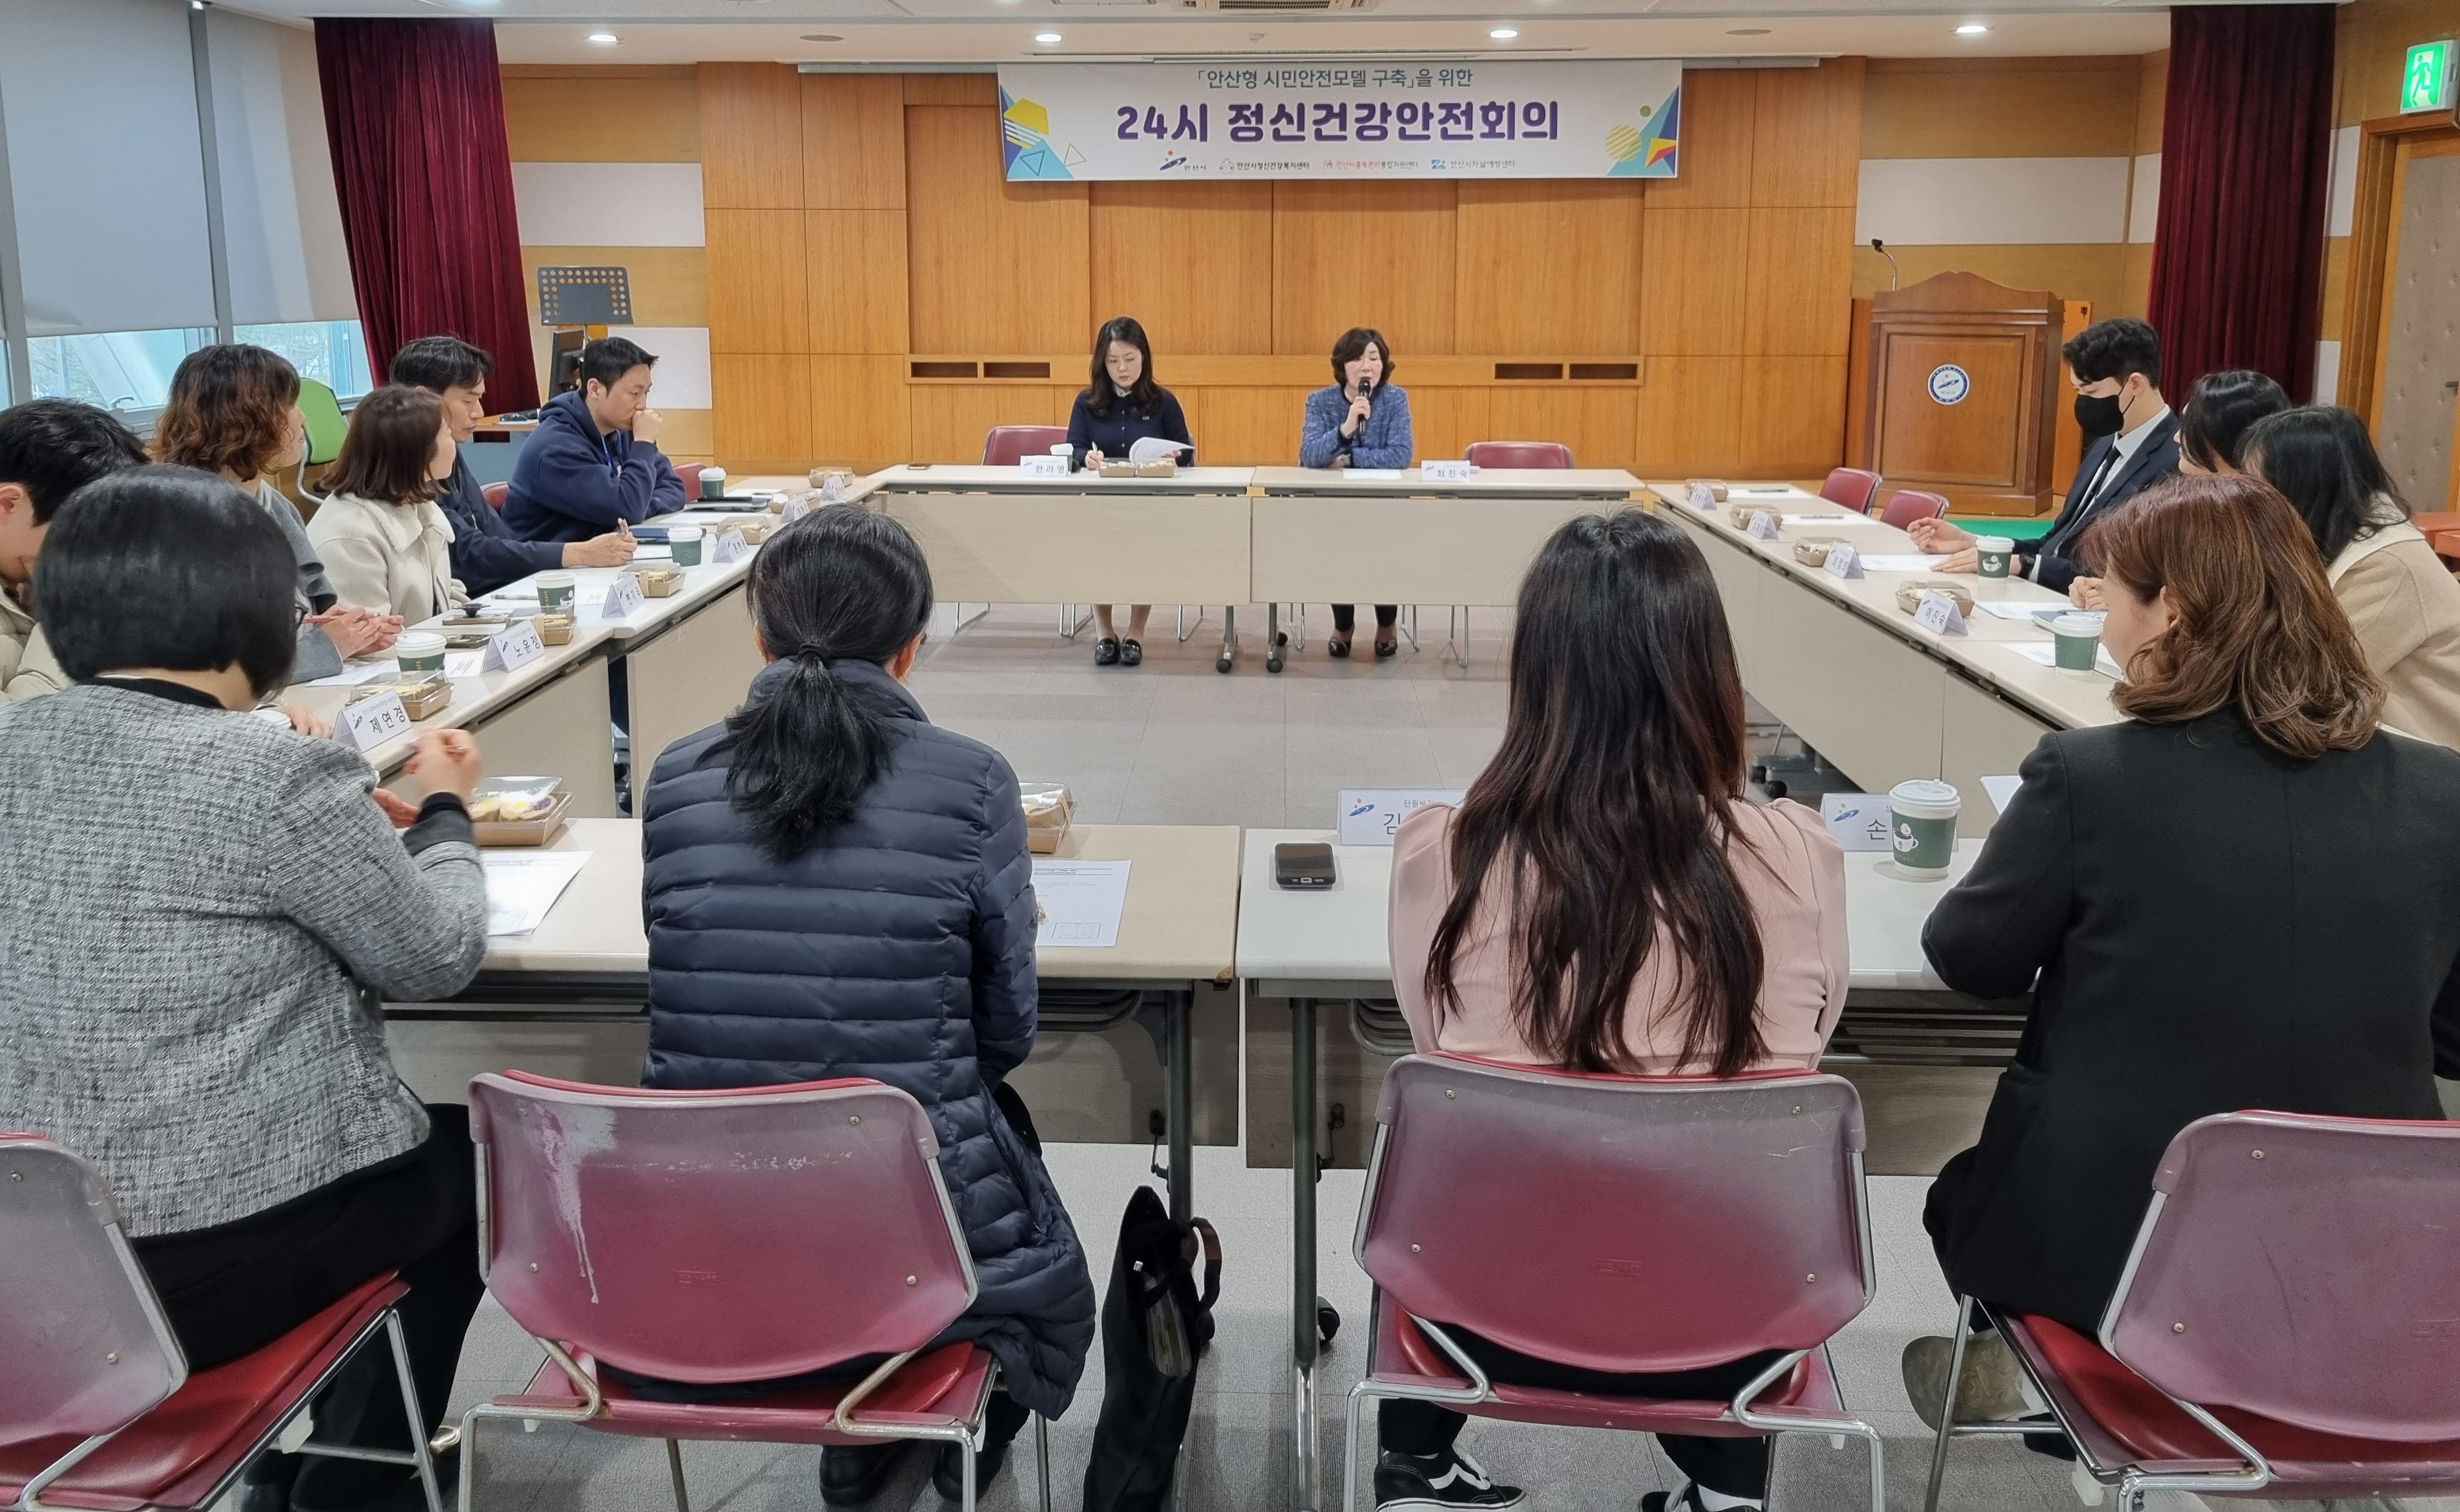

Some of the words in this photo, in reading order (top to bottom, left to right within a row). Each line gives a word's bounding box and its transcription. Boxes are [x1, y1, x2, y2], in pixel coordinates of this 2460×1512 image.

[1263, 70, 1366, 88] 시민안전모델
[1438, 68, 1473, 87] 위한
[1117, 102, 1208, 143] 24시
[1228, 100, 1559, 143] 정신건강안전회의
[1236, 162, 1310, 171] 안산시정신건강복지센터
[369, 706, 405, 734] 제연경
[1866, 819, 1887, 840] 손
